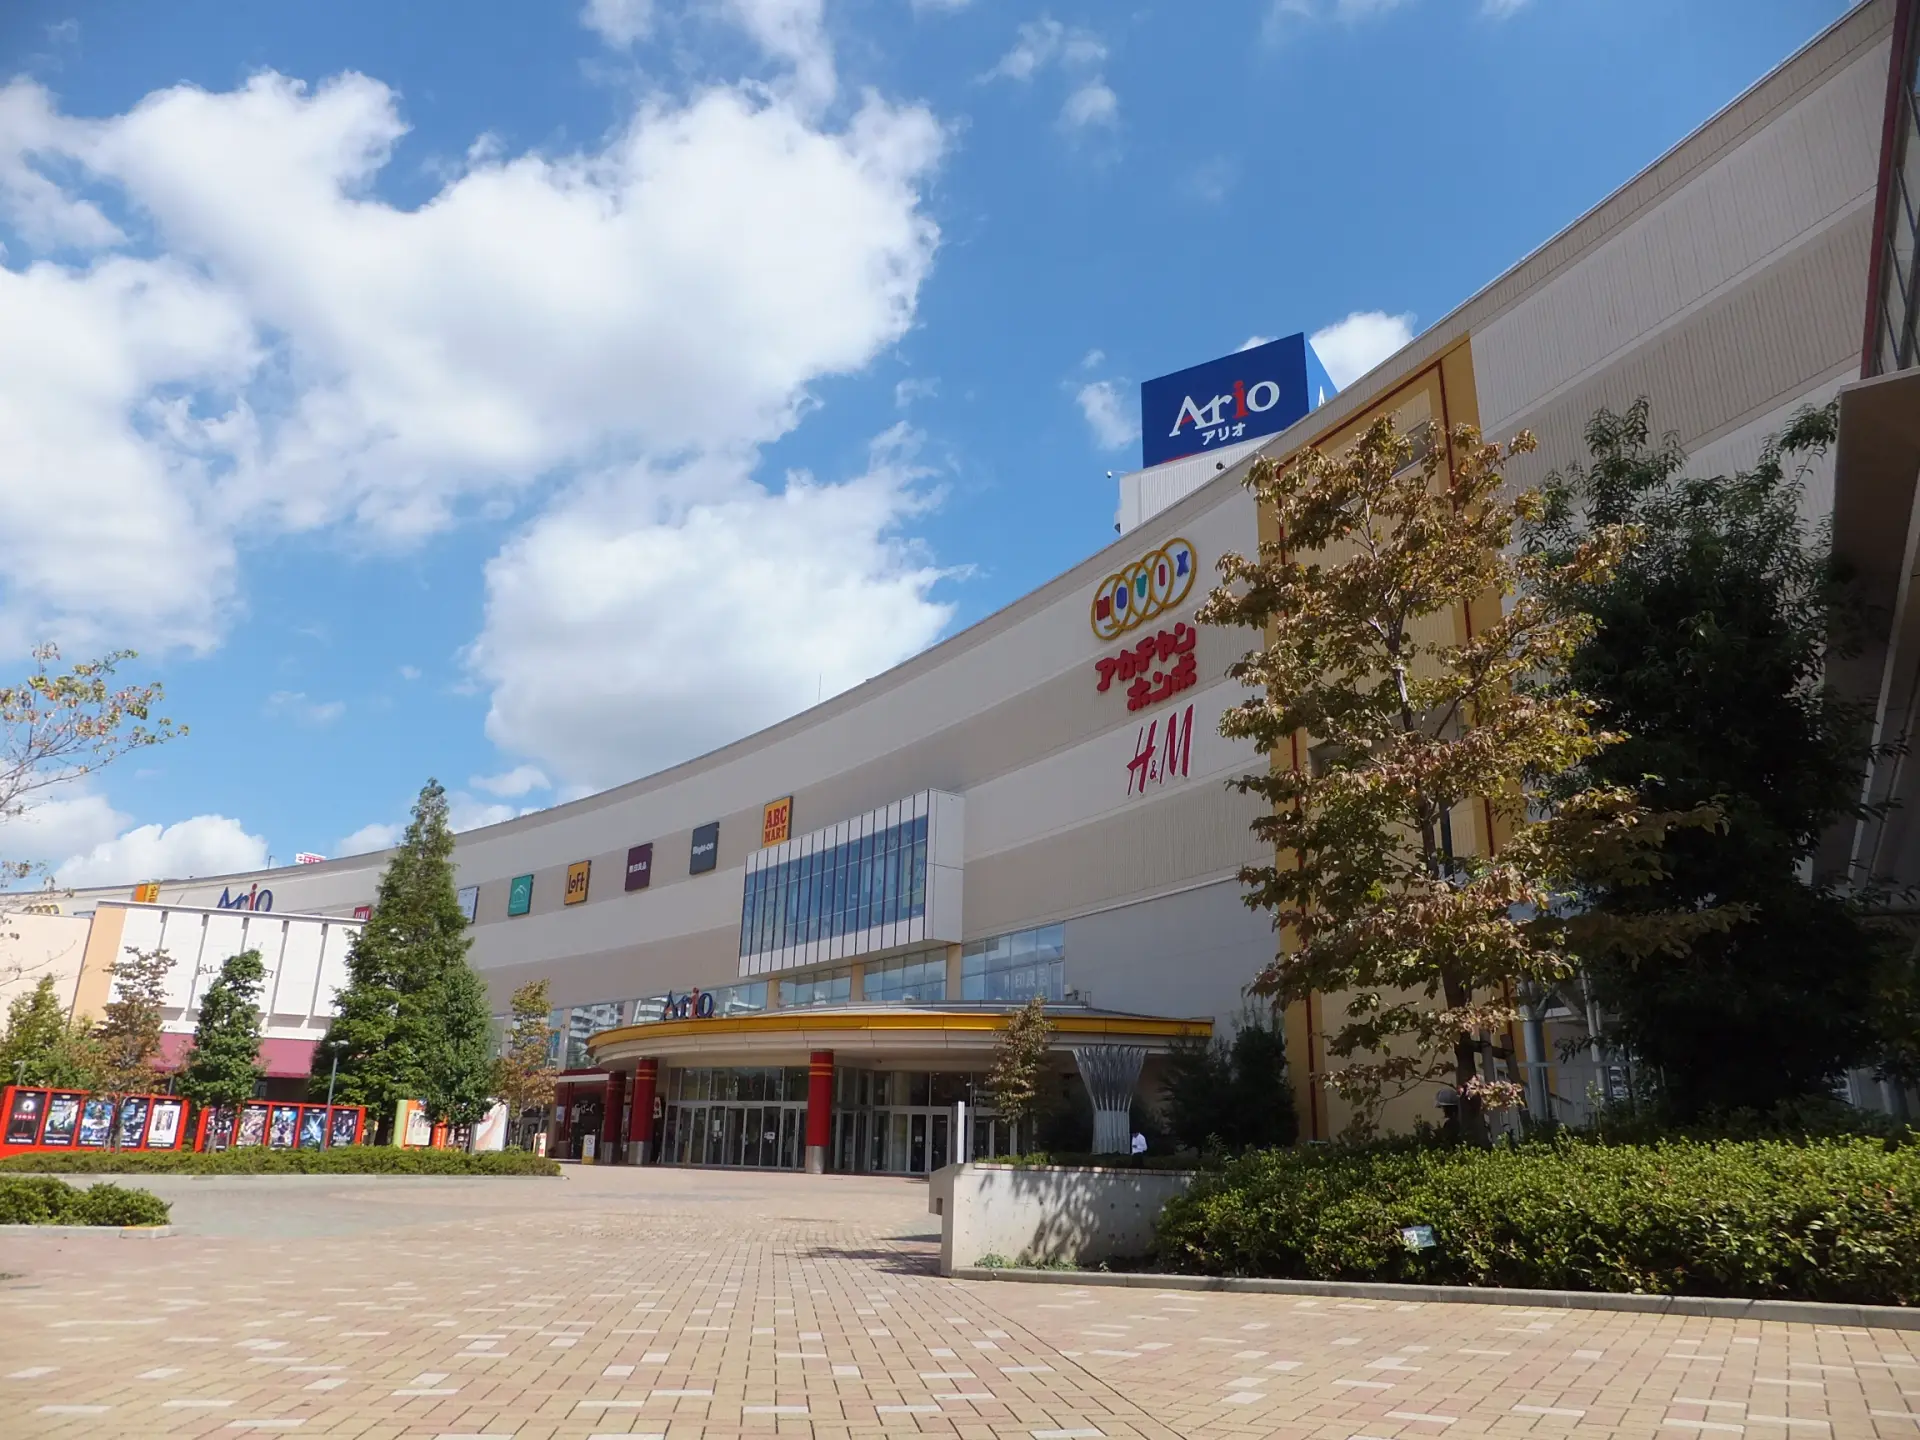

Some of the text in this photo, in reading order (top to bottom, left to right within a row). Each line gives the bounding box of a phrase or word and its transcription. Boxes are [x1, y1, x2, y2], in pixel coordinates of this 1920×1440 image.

[1169, 380, 1280, 437] Ario
[1202, 422, 1246, 445] アリオ
[1096, 550, 1189, 621] MOVIX
[1095, 622, 1196, 692] アカチャン
[1127, 704, 1194, 796] H&M
[765, 806, 788, 829] ABC
[765, 825, 787, 843] MART
[217, 883, 273, 912] Ario
[661, 988, 714, 1020] Ario
